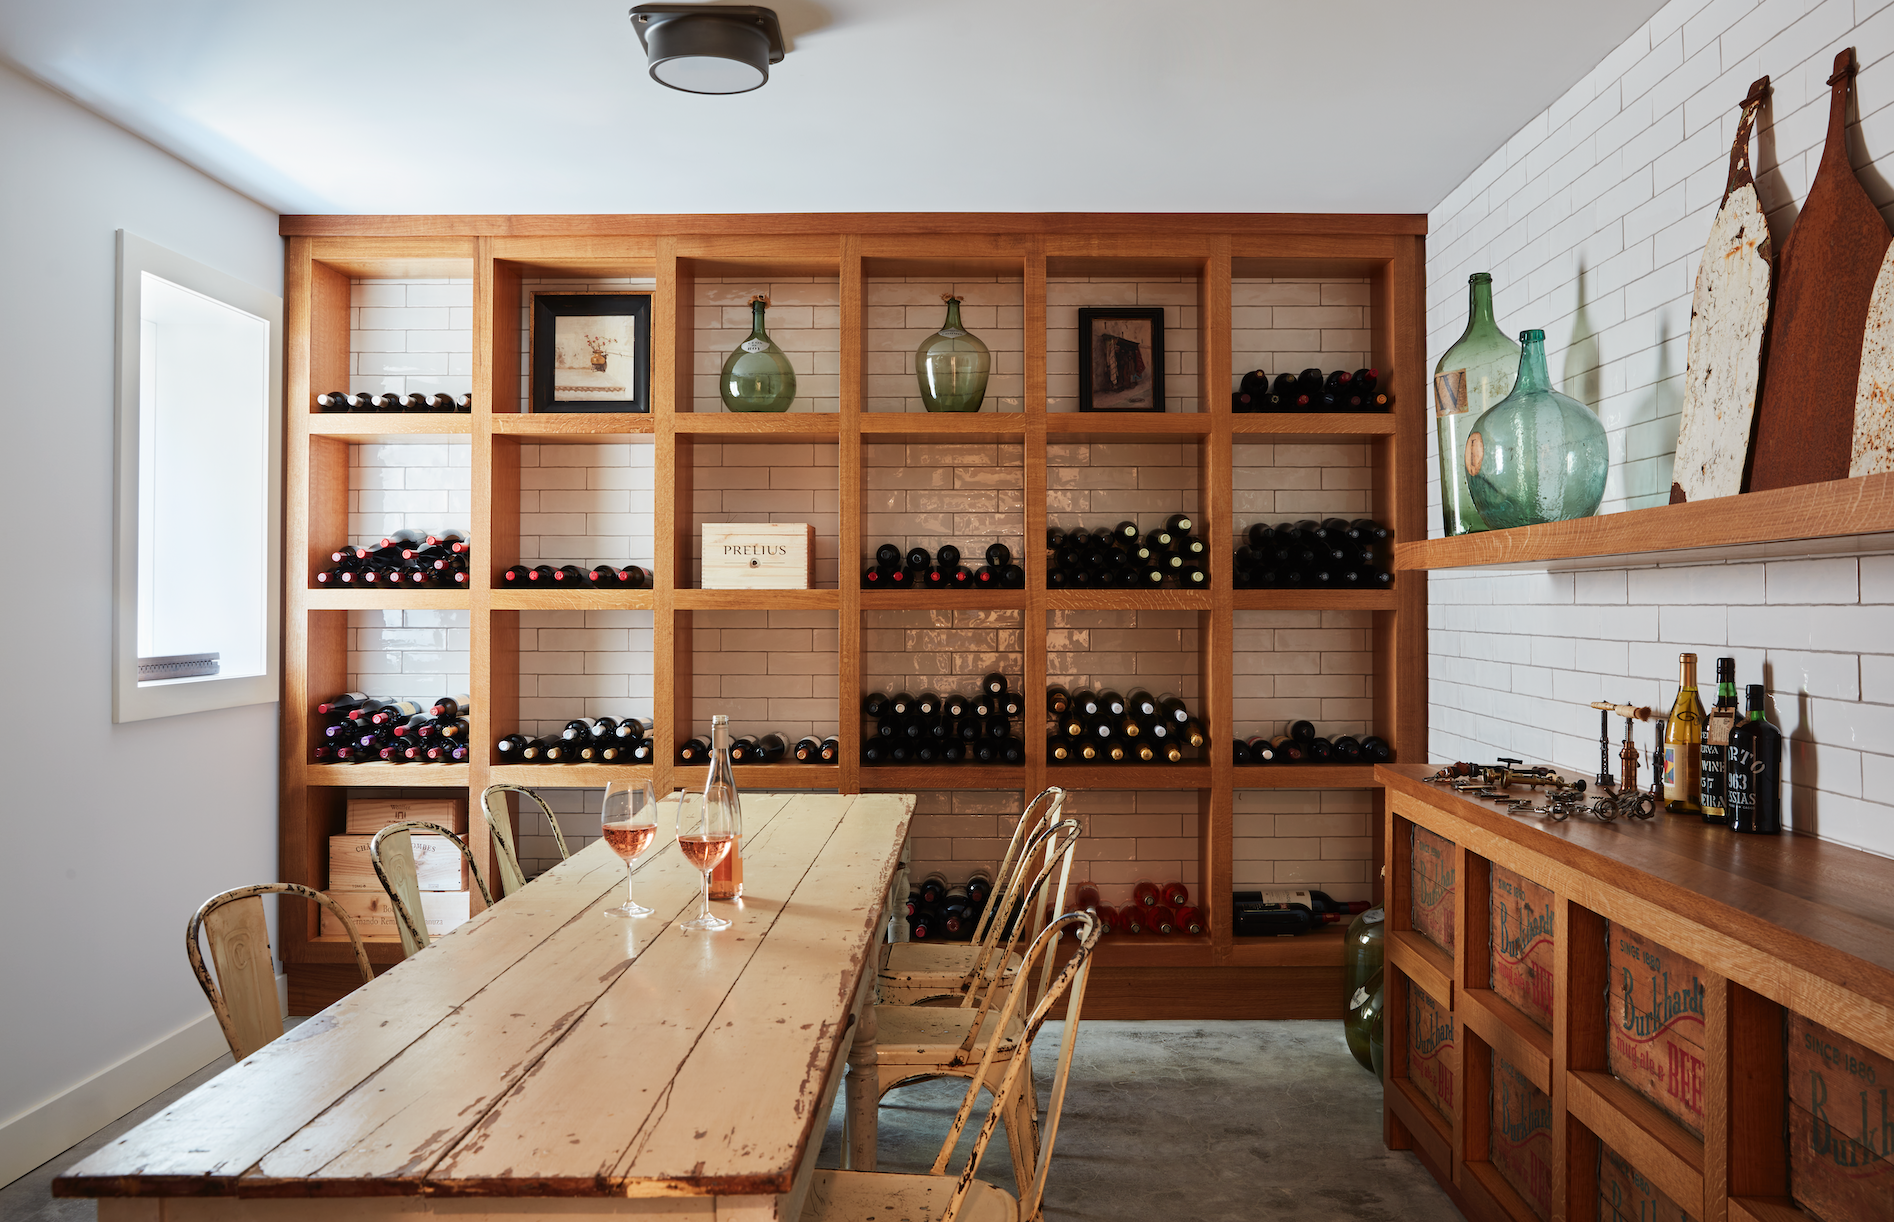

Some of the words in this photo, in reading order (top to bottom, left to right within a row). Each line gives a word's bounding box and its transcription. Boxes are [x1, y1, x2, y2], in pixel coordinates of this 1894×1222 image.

[723, 545, 787, 556] PRELIUS
[1619, 939, 1640, 961] SINCE
[1643, 951, 1661, 972] 1880
[1415, 1005, 1455, 1054] Burkhard
[1622, 966, 1705, 1037] Burkhardt
[1616, 1036, 1638, 1070] mug
[1639, 1050, 1655, 1076] ale
[1666, 1040, 1705, 1120] BEE
[1805, 1033, 1840, 1066] SINCE
[1845, 1053, 1876, 1085] 1880
[1501, 1080, 1553, 1143] Burkhard
[1809, 1069, 1894, 1168] Burkh
